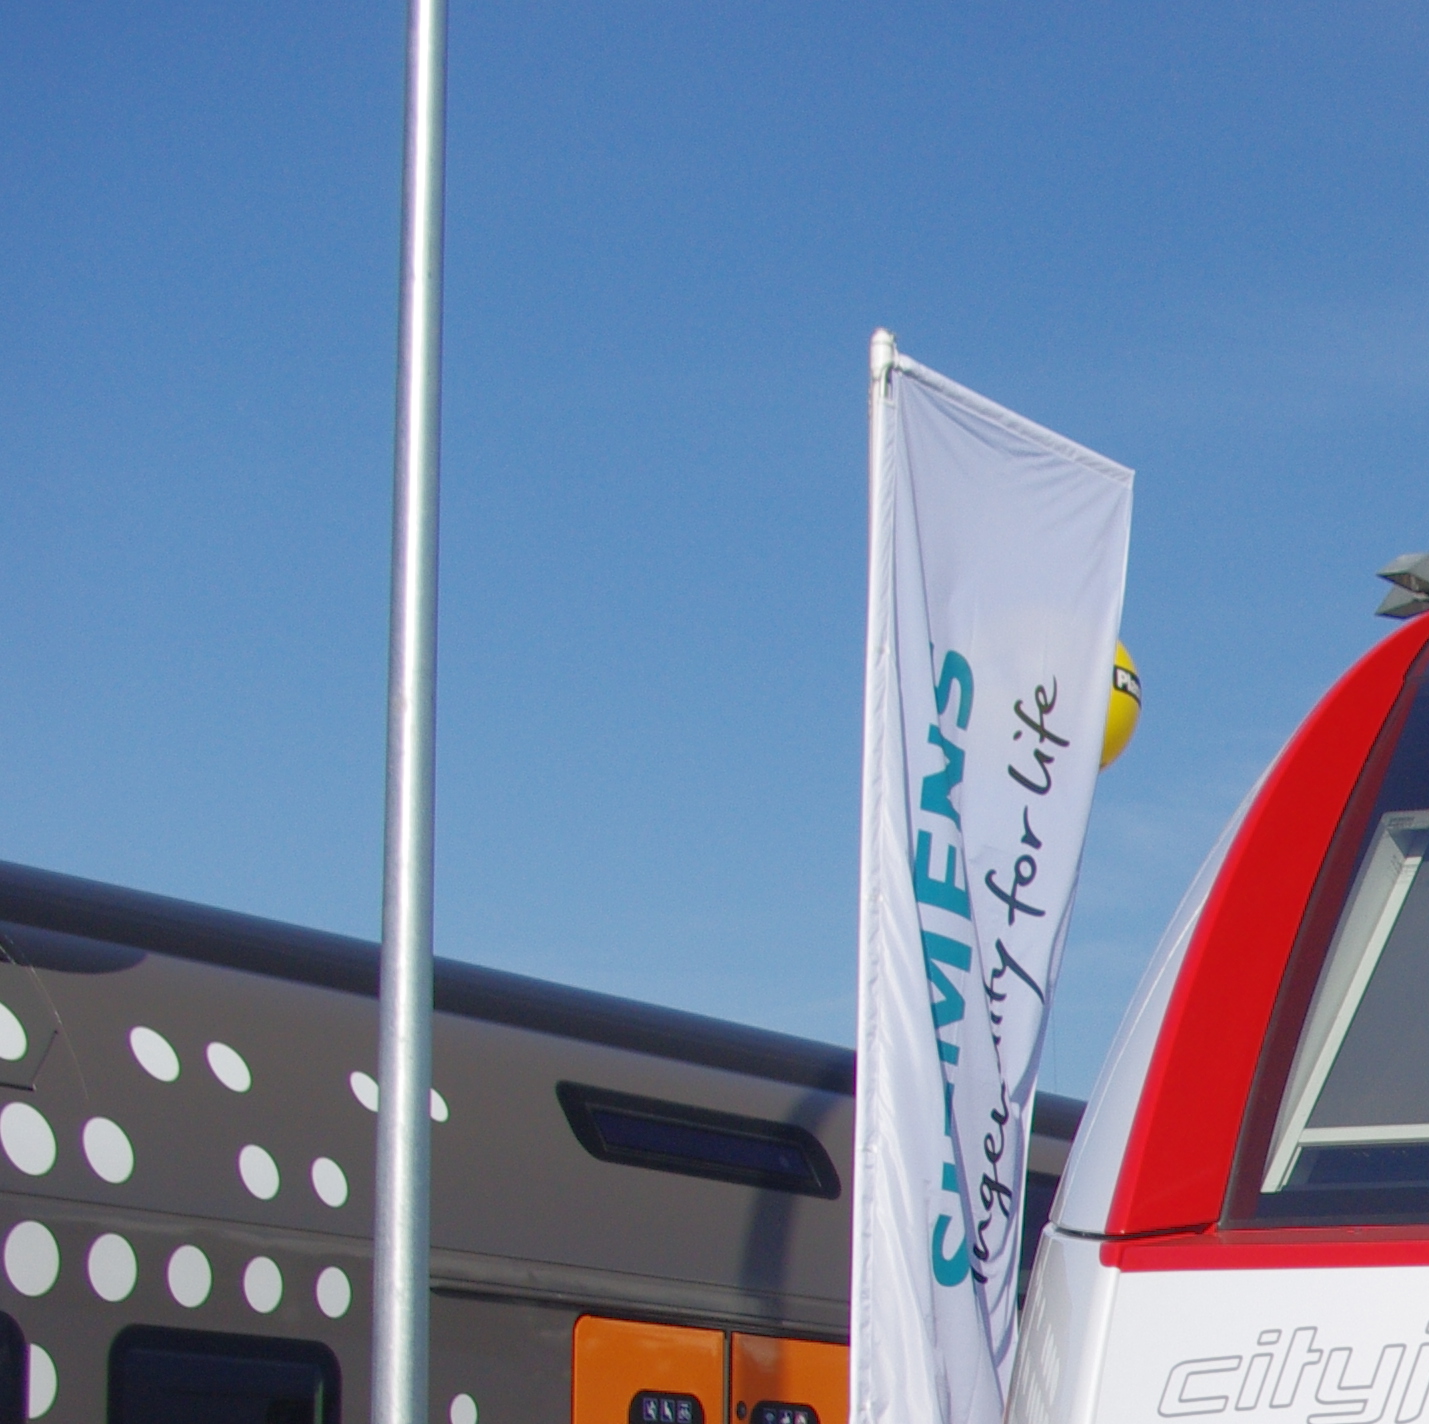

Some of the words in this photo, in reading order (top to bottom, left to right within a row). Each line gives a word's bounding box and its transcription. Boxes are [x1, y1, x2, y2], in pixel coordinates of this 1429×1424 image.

[1008, 674, 1070, 796] life
[985, 805, 1045, 926] for
[914, 643, 974, 1287] SMENS
